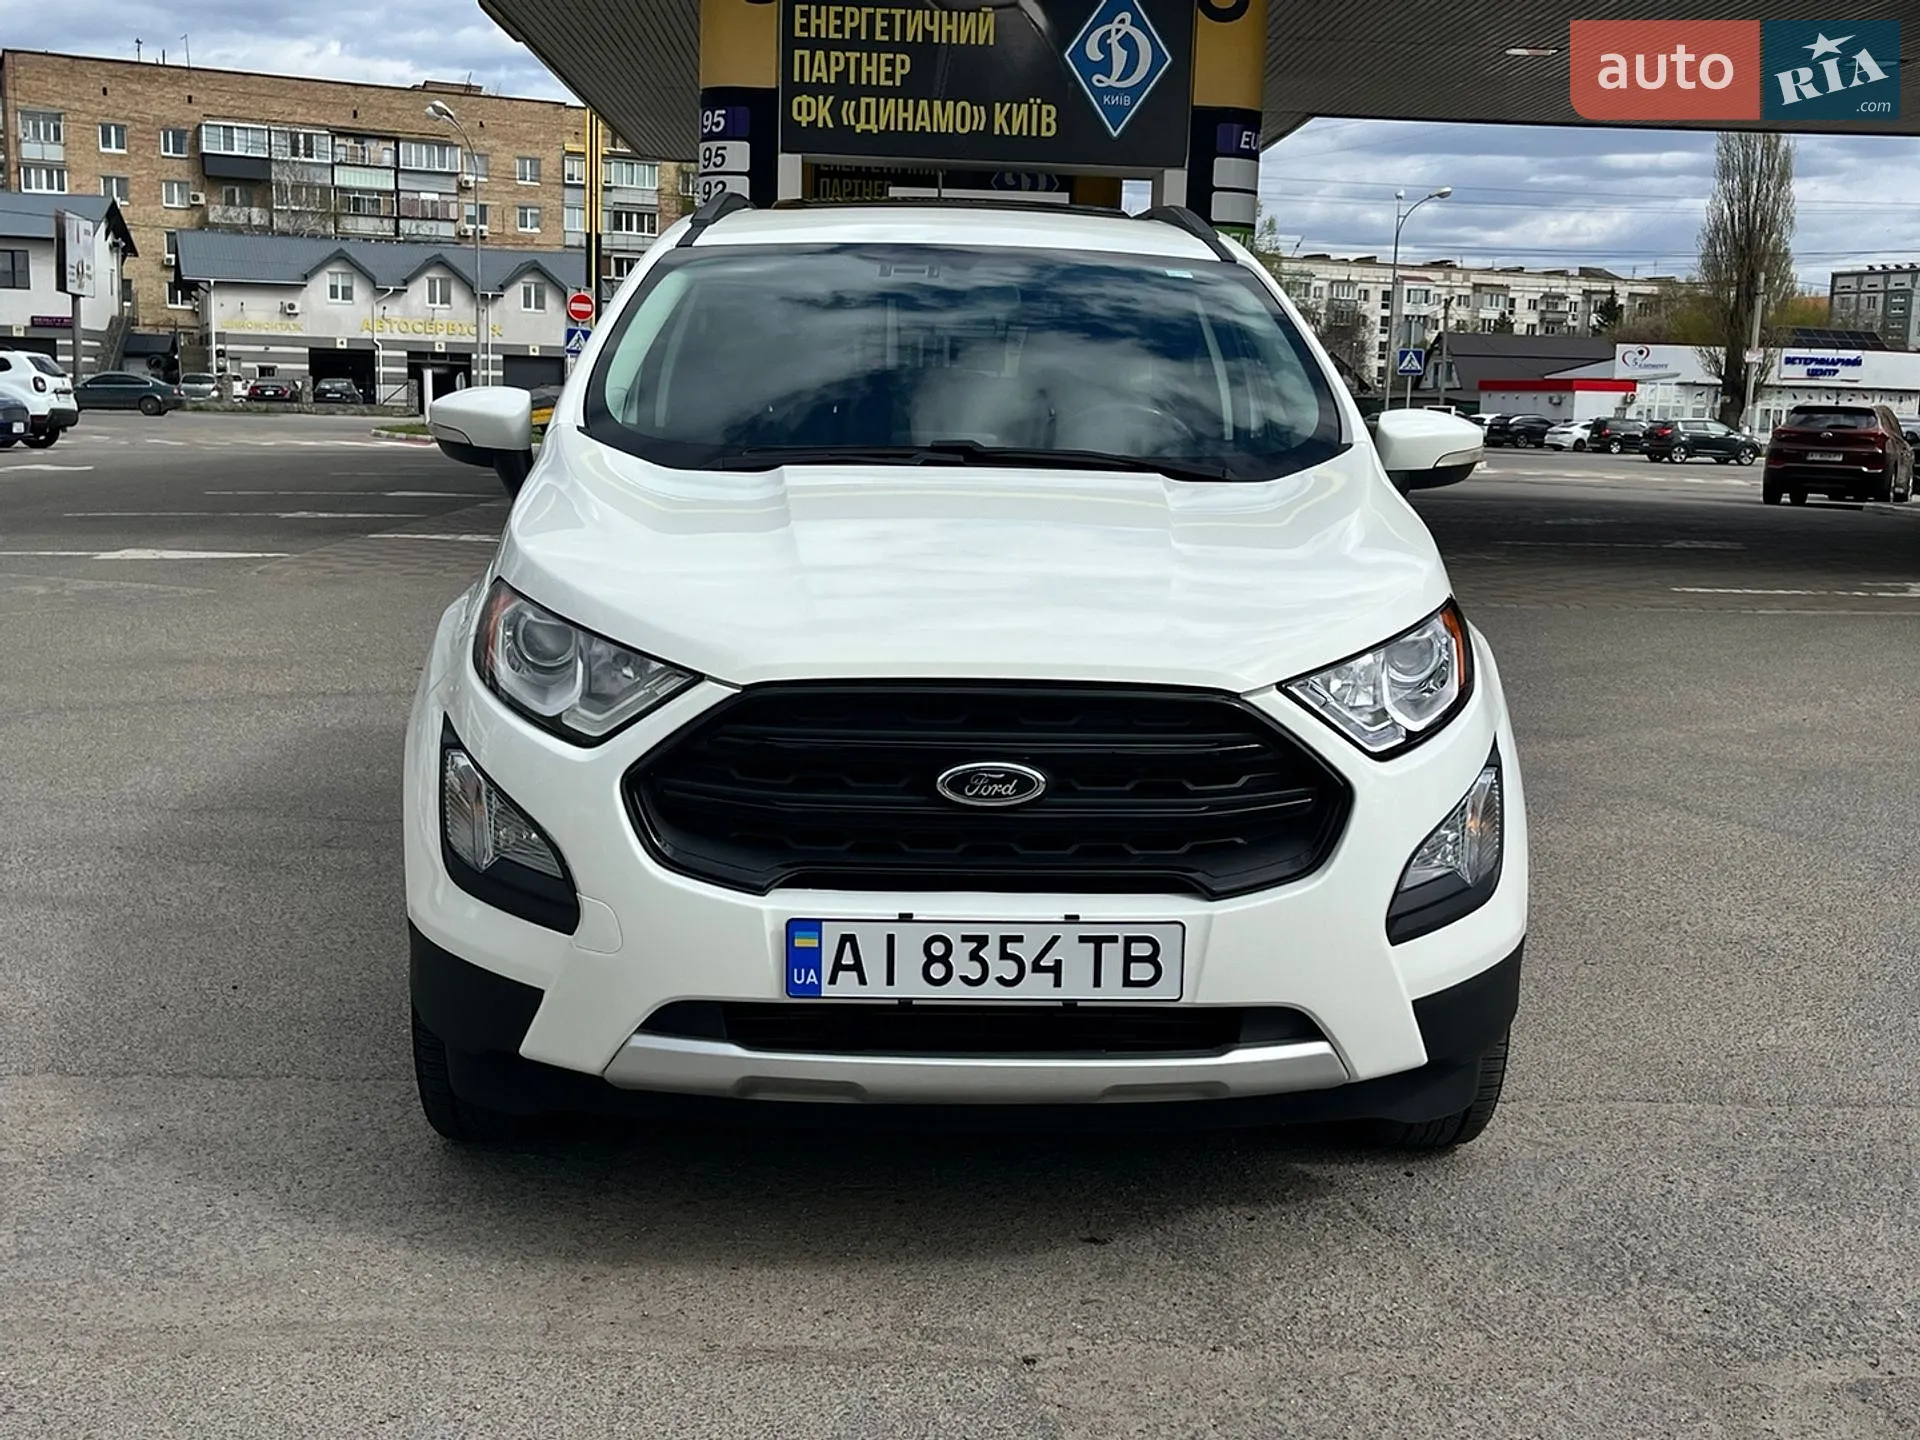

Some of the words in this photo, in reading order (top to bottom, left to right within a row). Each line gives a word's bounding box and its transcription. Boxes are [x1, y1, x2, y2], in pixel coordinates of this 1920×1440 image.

[793, 4, 996, 46] ЕНЕРГЕТИЧНИЙ
[793, 49, 911, 87] ПАРТНЕР
[1103, 92, 1131, 106] КИЇВ
[702, 109, 726, 133] 95
[791, 94, 834, 129] ФК
[841, 96, 987, 135] «ДИНАМО»
[993, 98, 1058, 138] КИЇВ
[702, 146, 727, 169] 95
[964, 773, 1018, 796] Ford
[921, 934, 1063, 988] 8354
[793, 968, 819, 985] UA
